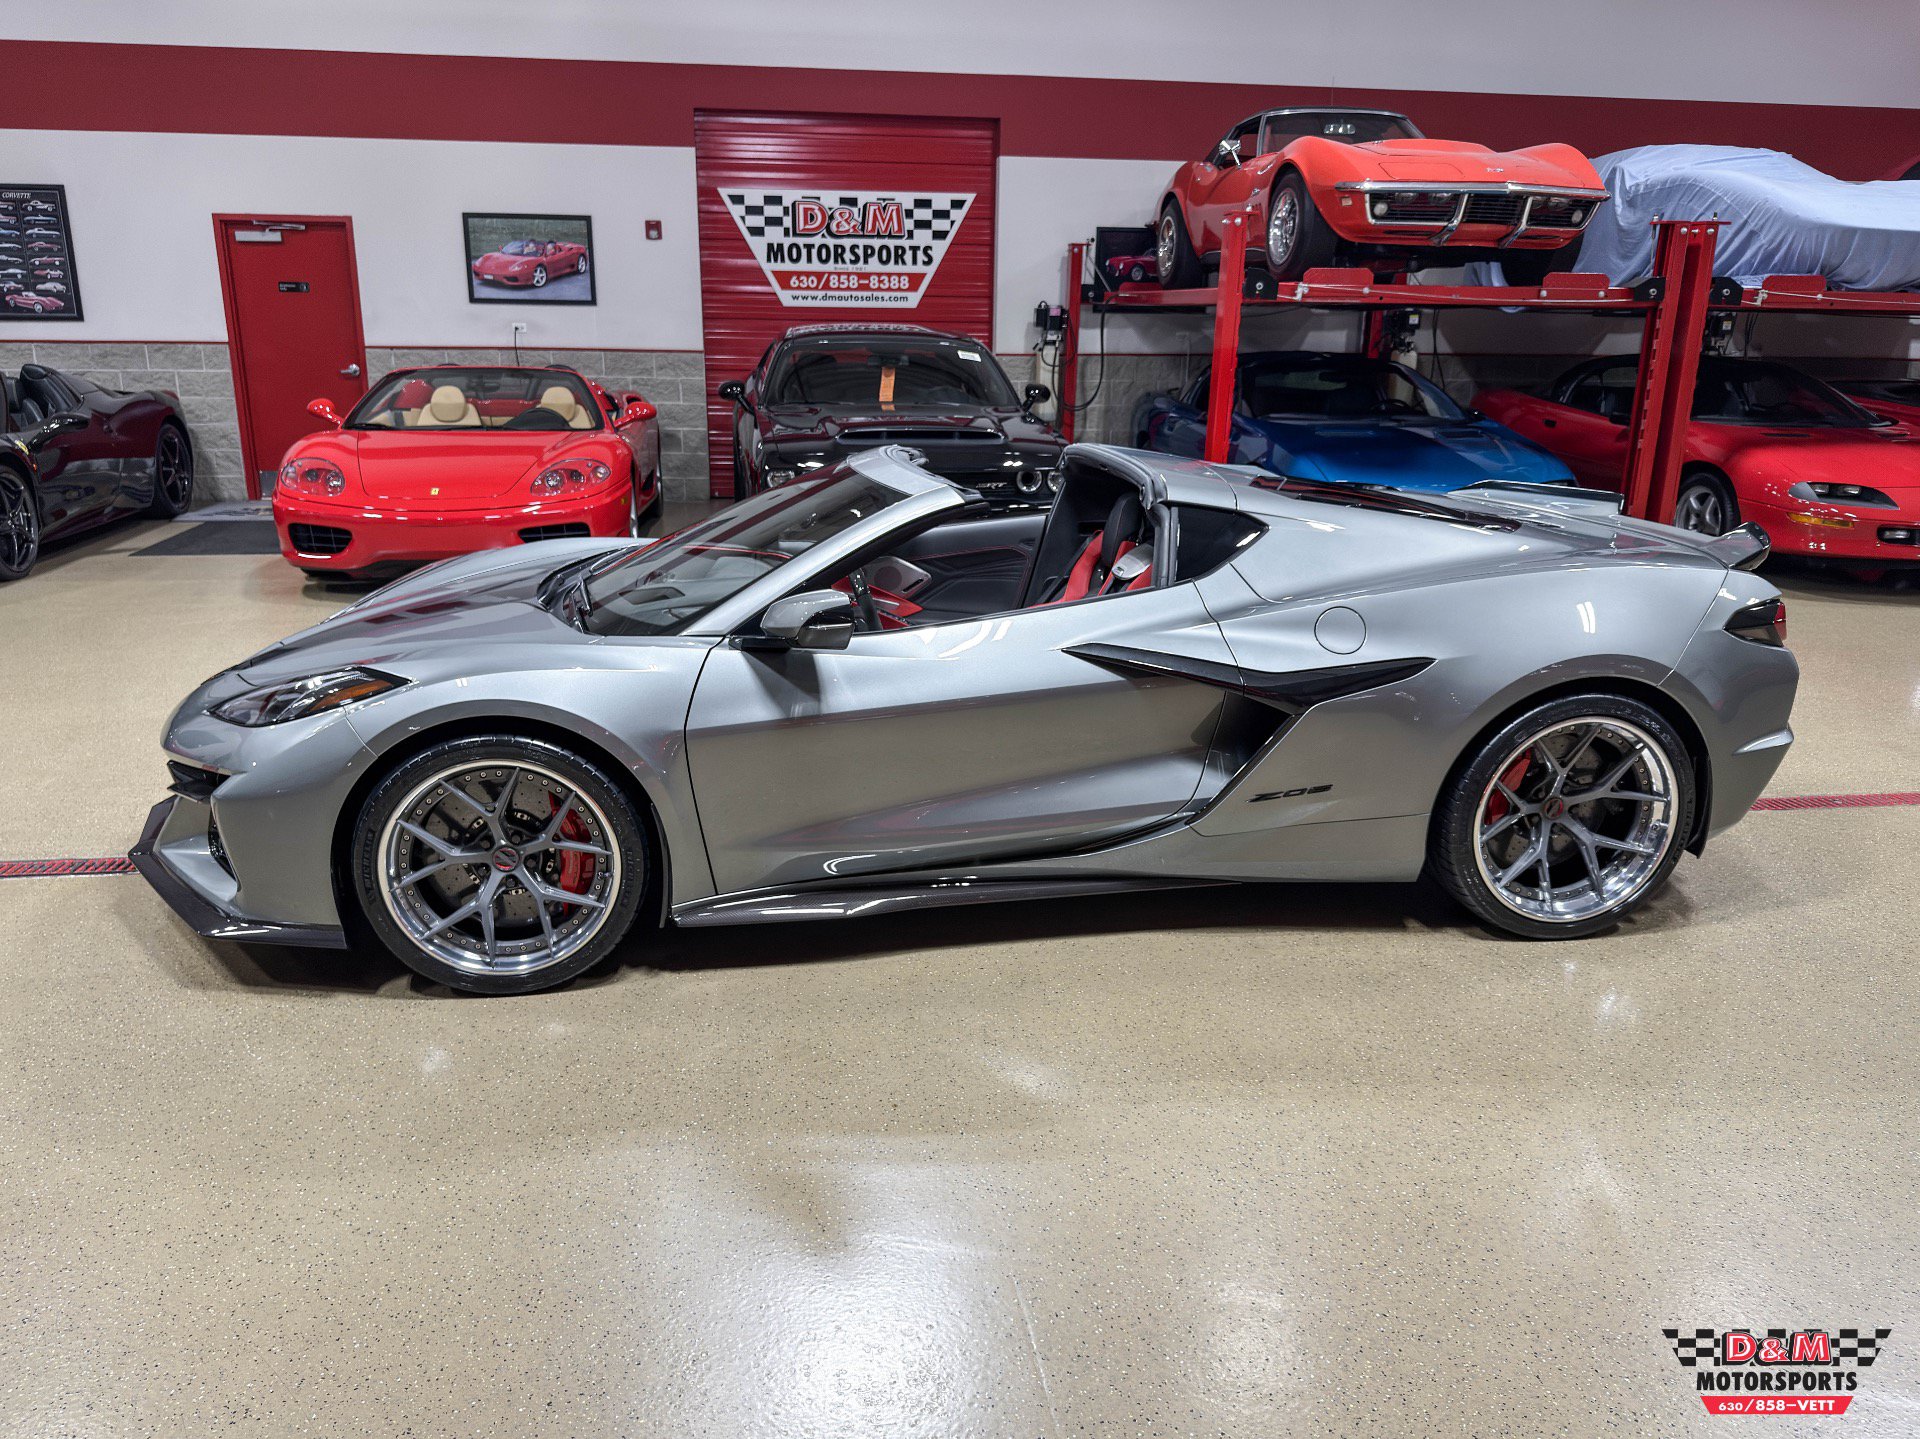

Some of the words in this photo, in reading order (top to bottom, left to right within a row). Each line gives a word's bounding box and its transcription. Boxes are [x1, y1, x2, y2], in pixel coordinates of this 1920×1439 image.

[2, 191, 31, 199] CORVETTE
[793, 200, 905, 238] D&M
[766, 242, 933, 266] MOTORSPORTS
[789, 273, 909, 290] 630/858-8388
[791, 293, 908, 303] www.dmautosales.com
